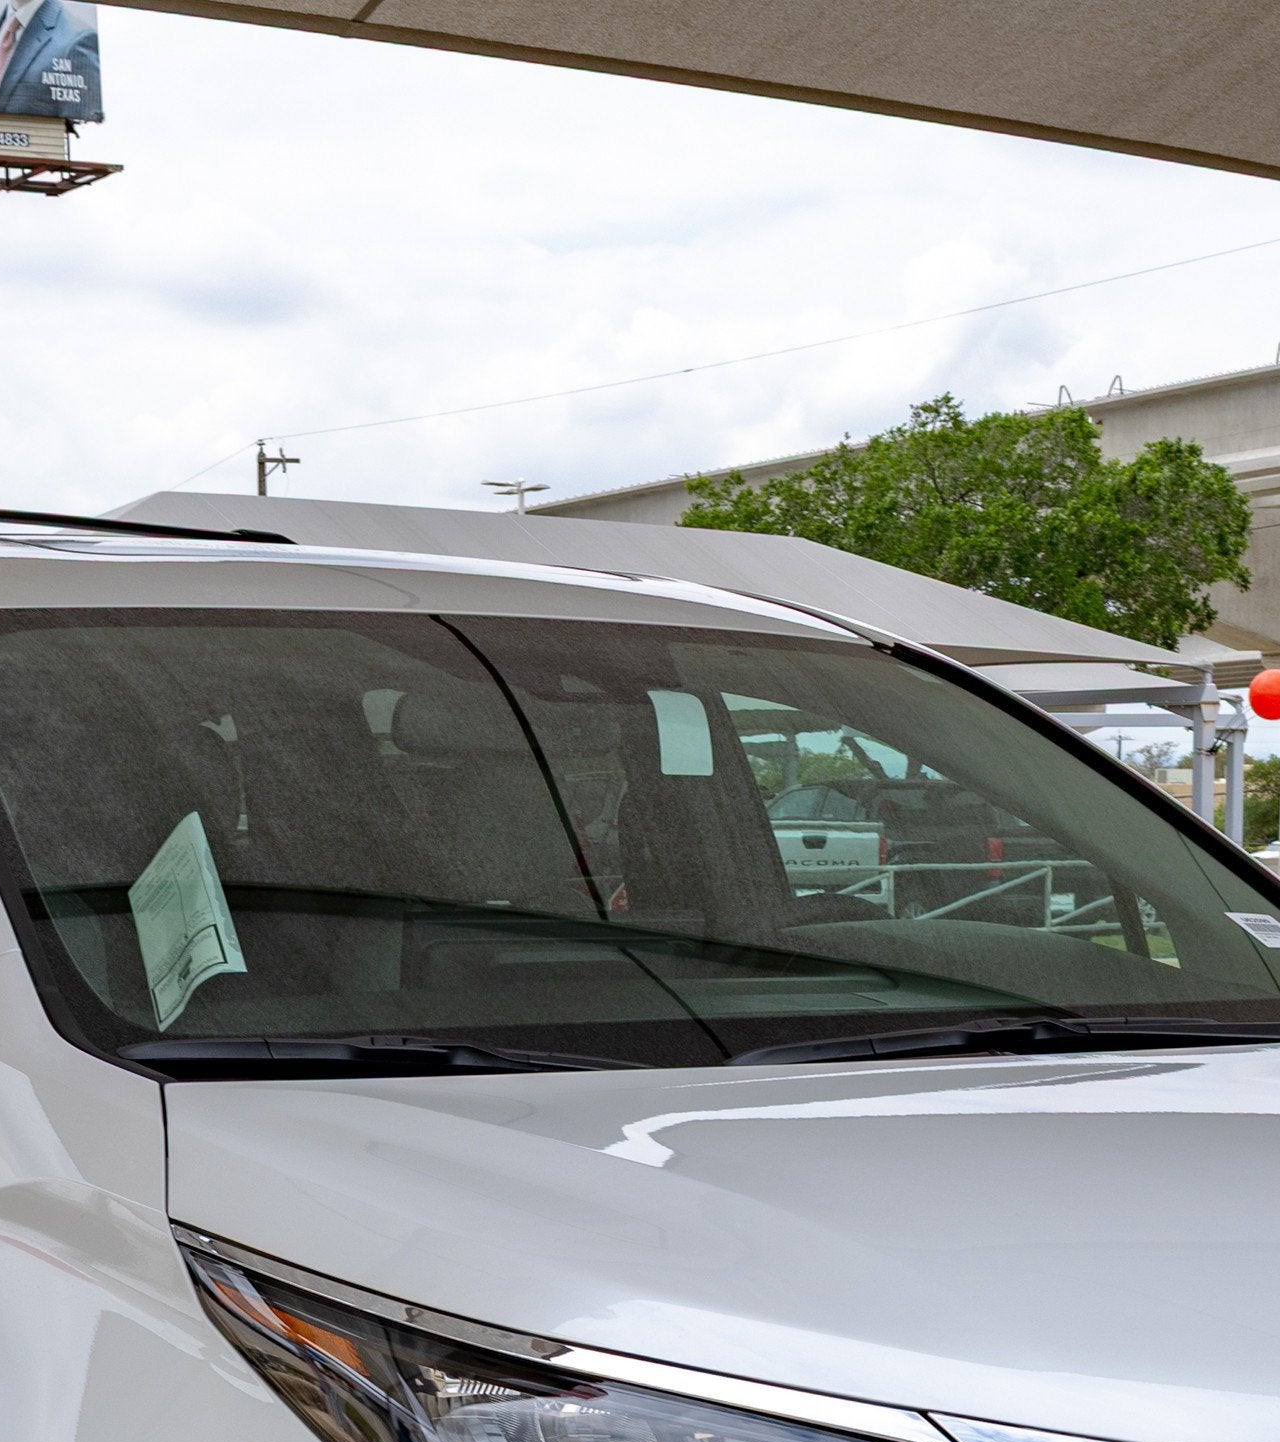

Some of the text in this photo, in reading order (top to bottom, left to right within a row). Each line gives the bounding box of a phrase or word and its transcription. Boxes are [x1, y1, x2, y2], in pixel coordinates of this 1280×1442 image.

[51, 57, 72, 73] SAN
[41, 71, 88, 90] ANTONIO,
[49, 86, 81, 103] TEXAS
[784, 859, 861, 867] ACOMA
